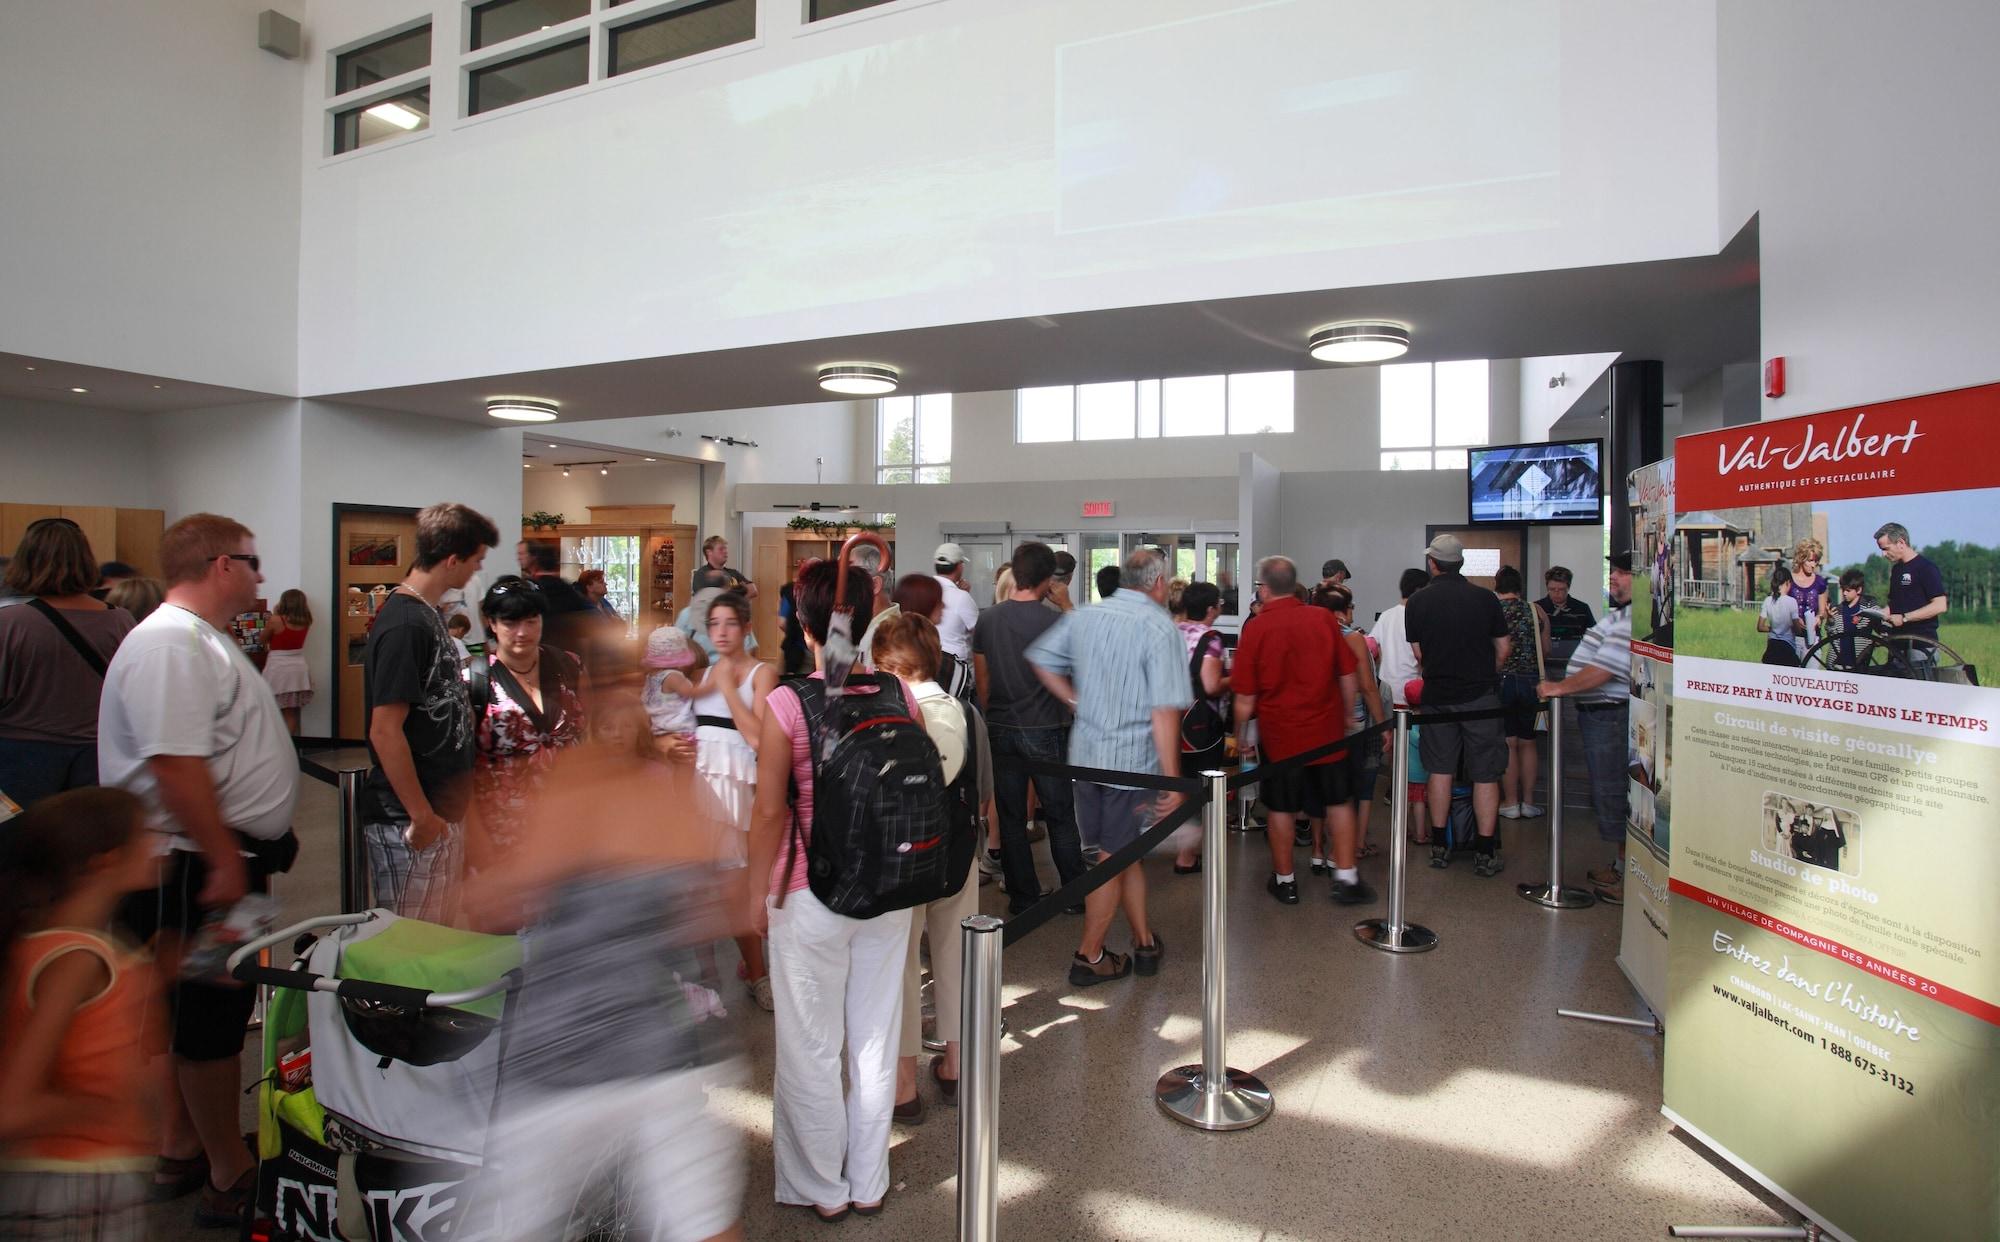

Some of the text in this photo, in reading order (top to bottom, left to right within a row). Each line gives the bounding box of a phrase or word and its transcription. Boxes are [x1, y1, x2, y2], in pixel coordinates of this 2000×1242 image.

[1718, 413, 1926, 476] Val-Jalbert
[1739, 469, 1896, 492] AUTHENTIQUE ET SPECTACULAIRE
[1083, 502, 1112, 514] SORTIE
[1687, 680, 1988, 732] PRENEZ PART À UN VOYAGE DANS LE TEMPS
[1772, 673, 1859, 695] NOUVEAUTÉS
[1691, 726, 1707, 736] Cette
[1708, 728, 1730, 740] chasse
[1799, 746, 1828, 759] idéale
[1830, 753, 1850, 766] pour
[1852, 756, 1864, 766] les
[1865, 759, 1903, 775] familles,
[1905, 767, 1933, 780] petits
[1935, 774, 1979, 790] groupes
[1714, 711, 1937, 765] Circuit de visite géorallye
[1721, 740, 1730, 749] de
[1731, 743, 1764, 757] nouvelles
[1813, 761, 1824, 769] se
[1826, 762, 1841, 773] fait
[1870, 772, 1888, 783] GPS
[1890, 777, 1900, 786] et
[1902, 779, 1914, 789] un
[1916, 783, 1990, 804] questionnaire.
[1748, 758, 1756, 767] 15
[1757, 761, 1781, 773] caches
[1816, 773, 1857, 789] différents
[1858, 784, 1894, 799] endroits
[1895, 793, 1911, 803] sur
[1913, 795, 1923, 805] le
[1925, 799, 1944, 810] site
[1779, 776, 1787, 784] et
[1788, 778, 1797, 787] de
[1798, 781, 1853, 800] coordonnées
[1750, 849, 1879, 904] Studio de photo
[1706, 895, 1719, 908] UN
[1721, 900, 1759, 922] VILLAGE
[1761, 916, 1774, 929] DE
[1776, 923, 1839, 954] COMPAGNIE
[1841, 949, 1863, 965] DES
[1866, 960, 1918, 987] ANNÉES
[1921, 982, 1938, 995] 20
[1823, 906, 1848, 921] photo
[1849, 914, 1861, 926] de
[1894, 930, 1919, 948] toute
[1882, 915, 1902, 929] sont
[1912, 925, 1921, 936] la
[1923, 930, 1982, 959] disposition
[1712, 929, 1921, 1042] Entrez dans l'histoire
[1712, 983, 1914, 1096] www.valjalbert.com 1 888 675-3132
[1778, 997, 1846, 1039] LAC-SAINT-JEAN
[1853, 1032, 1891, 1062] QUÉBEC
